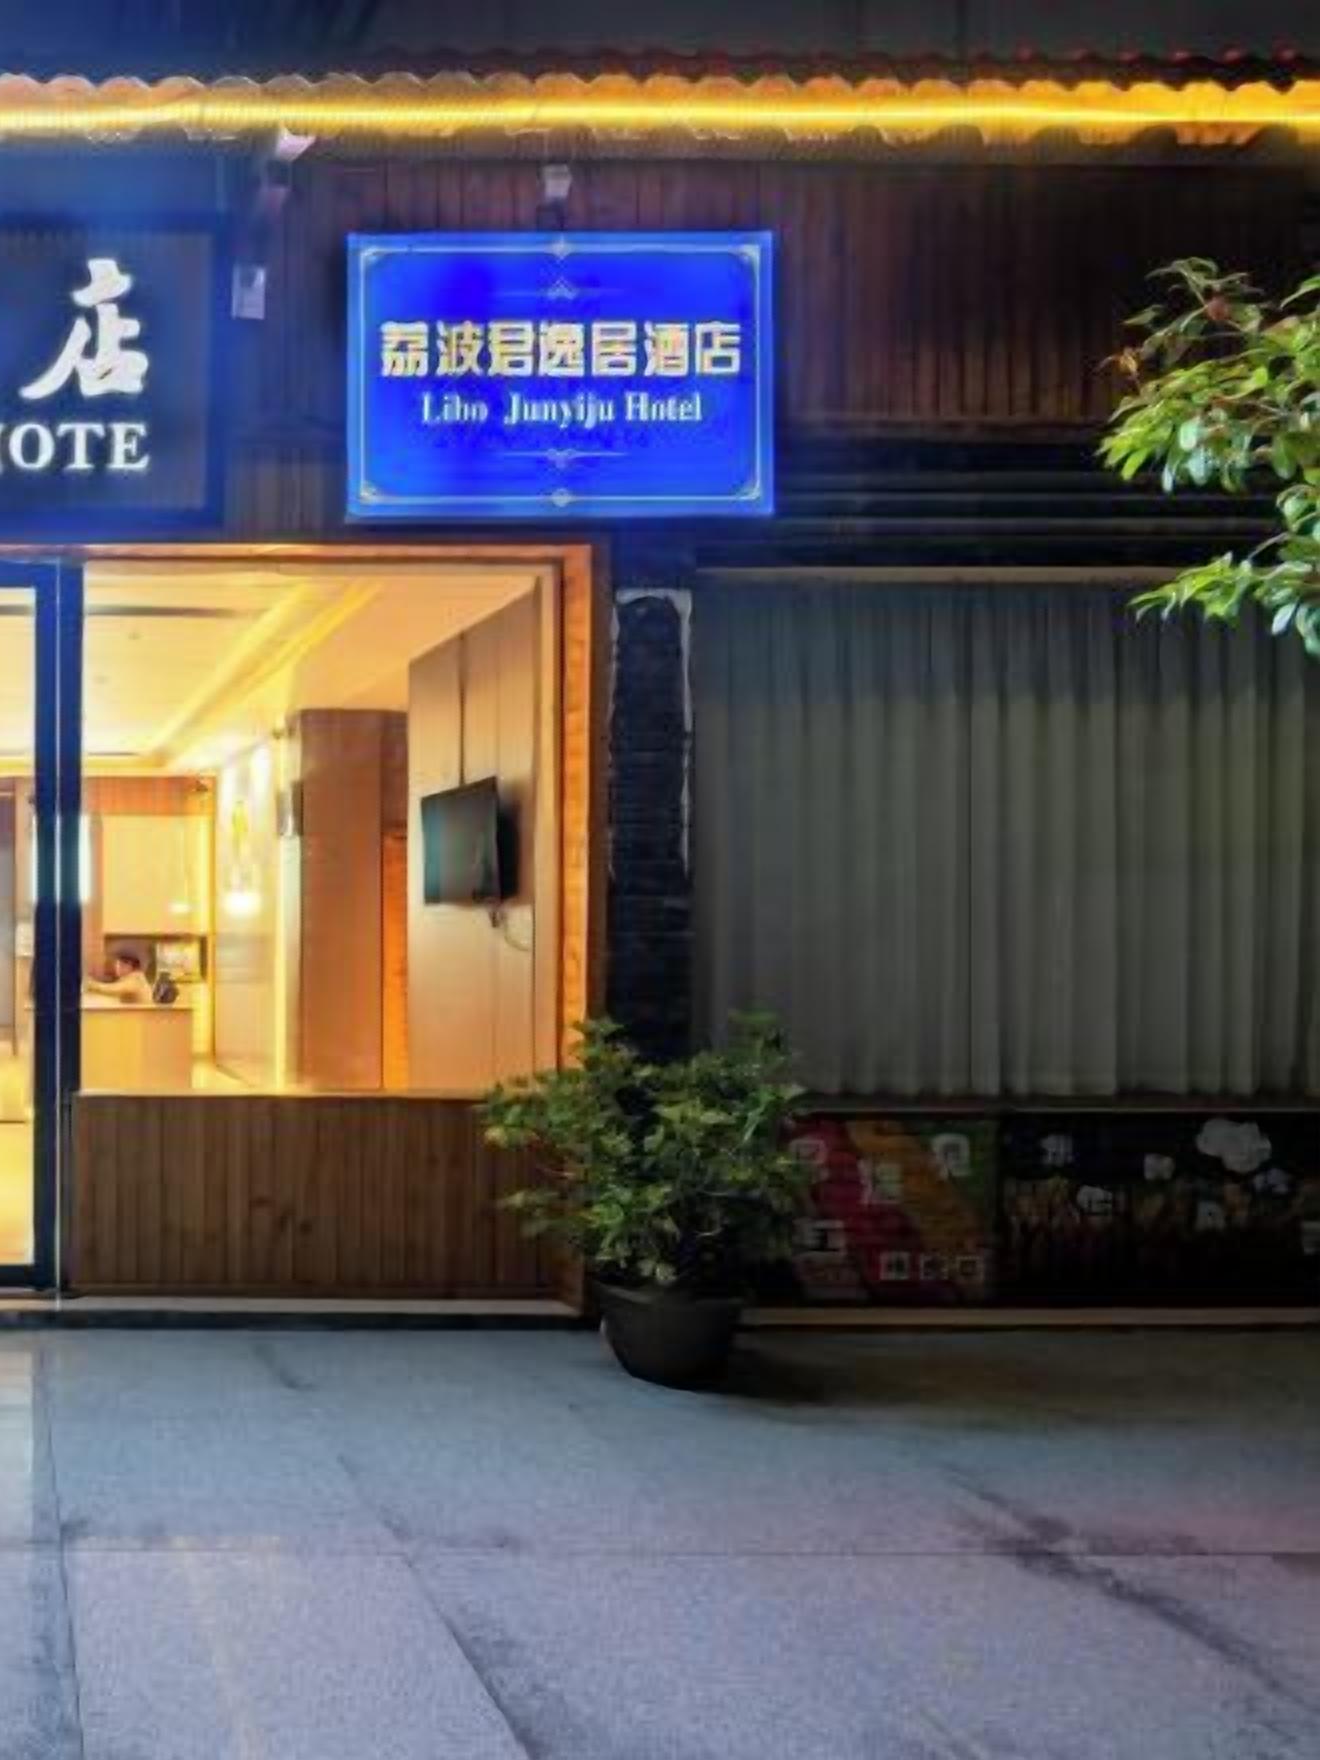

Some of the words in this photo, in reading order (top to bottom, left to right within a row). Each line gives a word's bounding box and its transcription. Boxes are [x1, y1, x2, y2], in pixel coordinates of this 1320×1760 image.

[380, 319, 741, 377] 荔波君逸居酒店
[422, 391, 488, 425] Libo
[503, 391, 615, 429] Junyiju
[624, 391, 702, 423] Hotel
